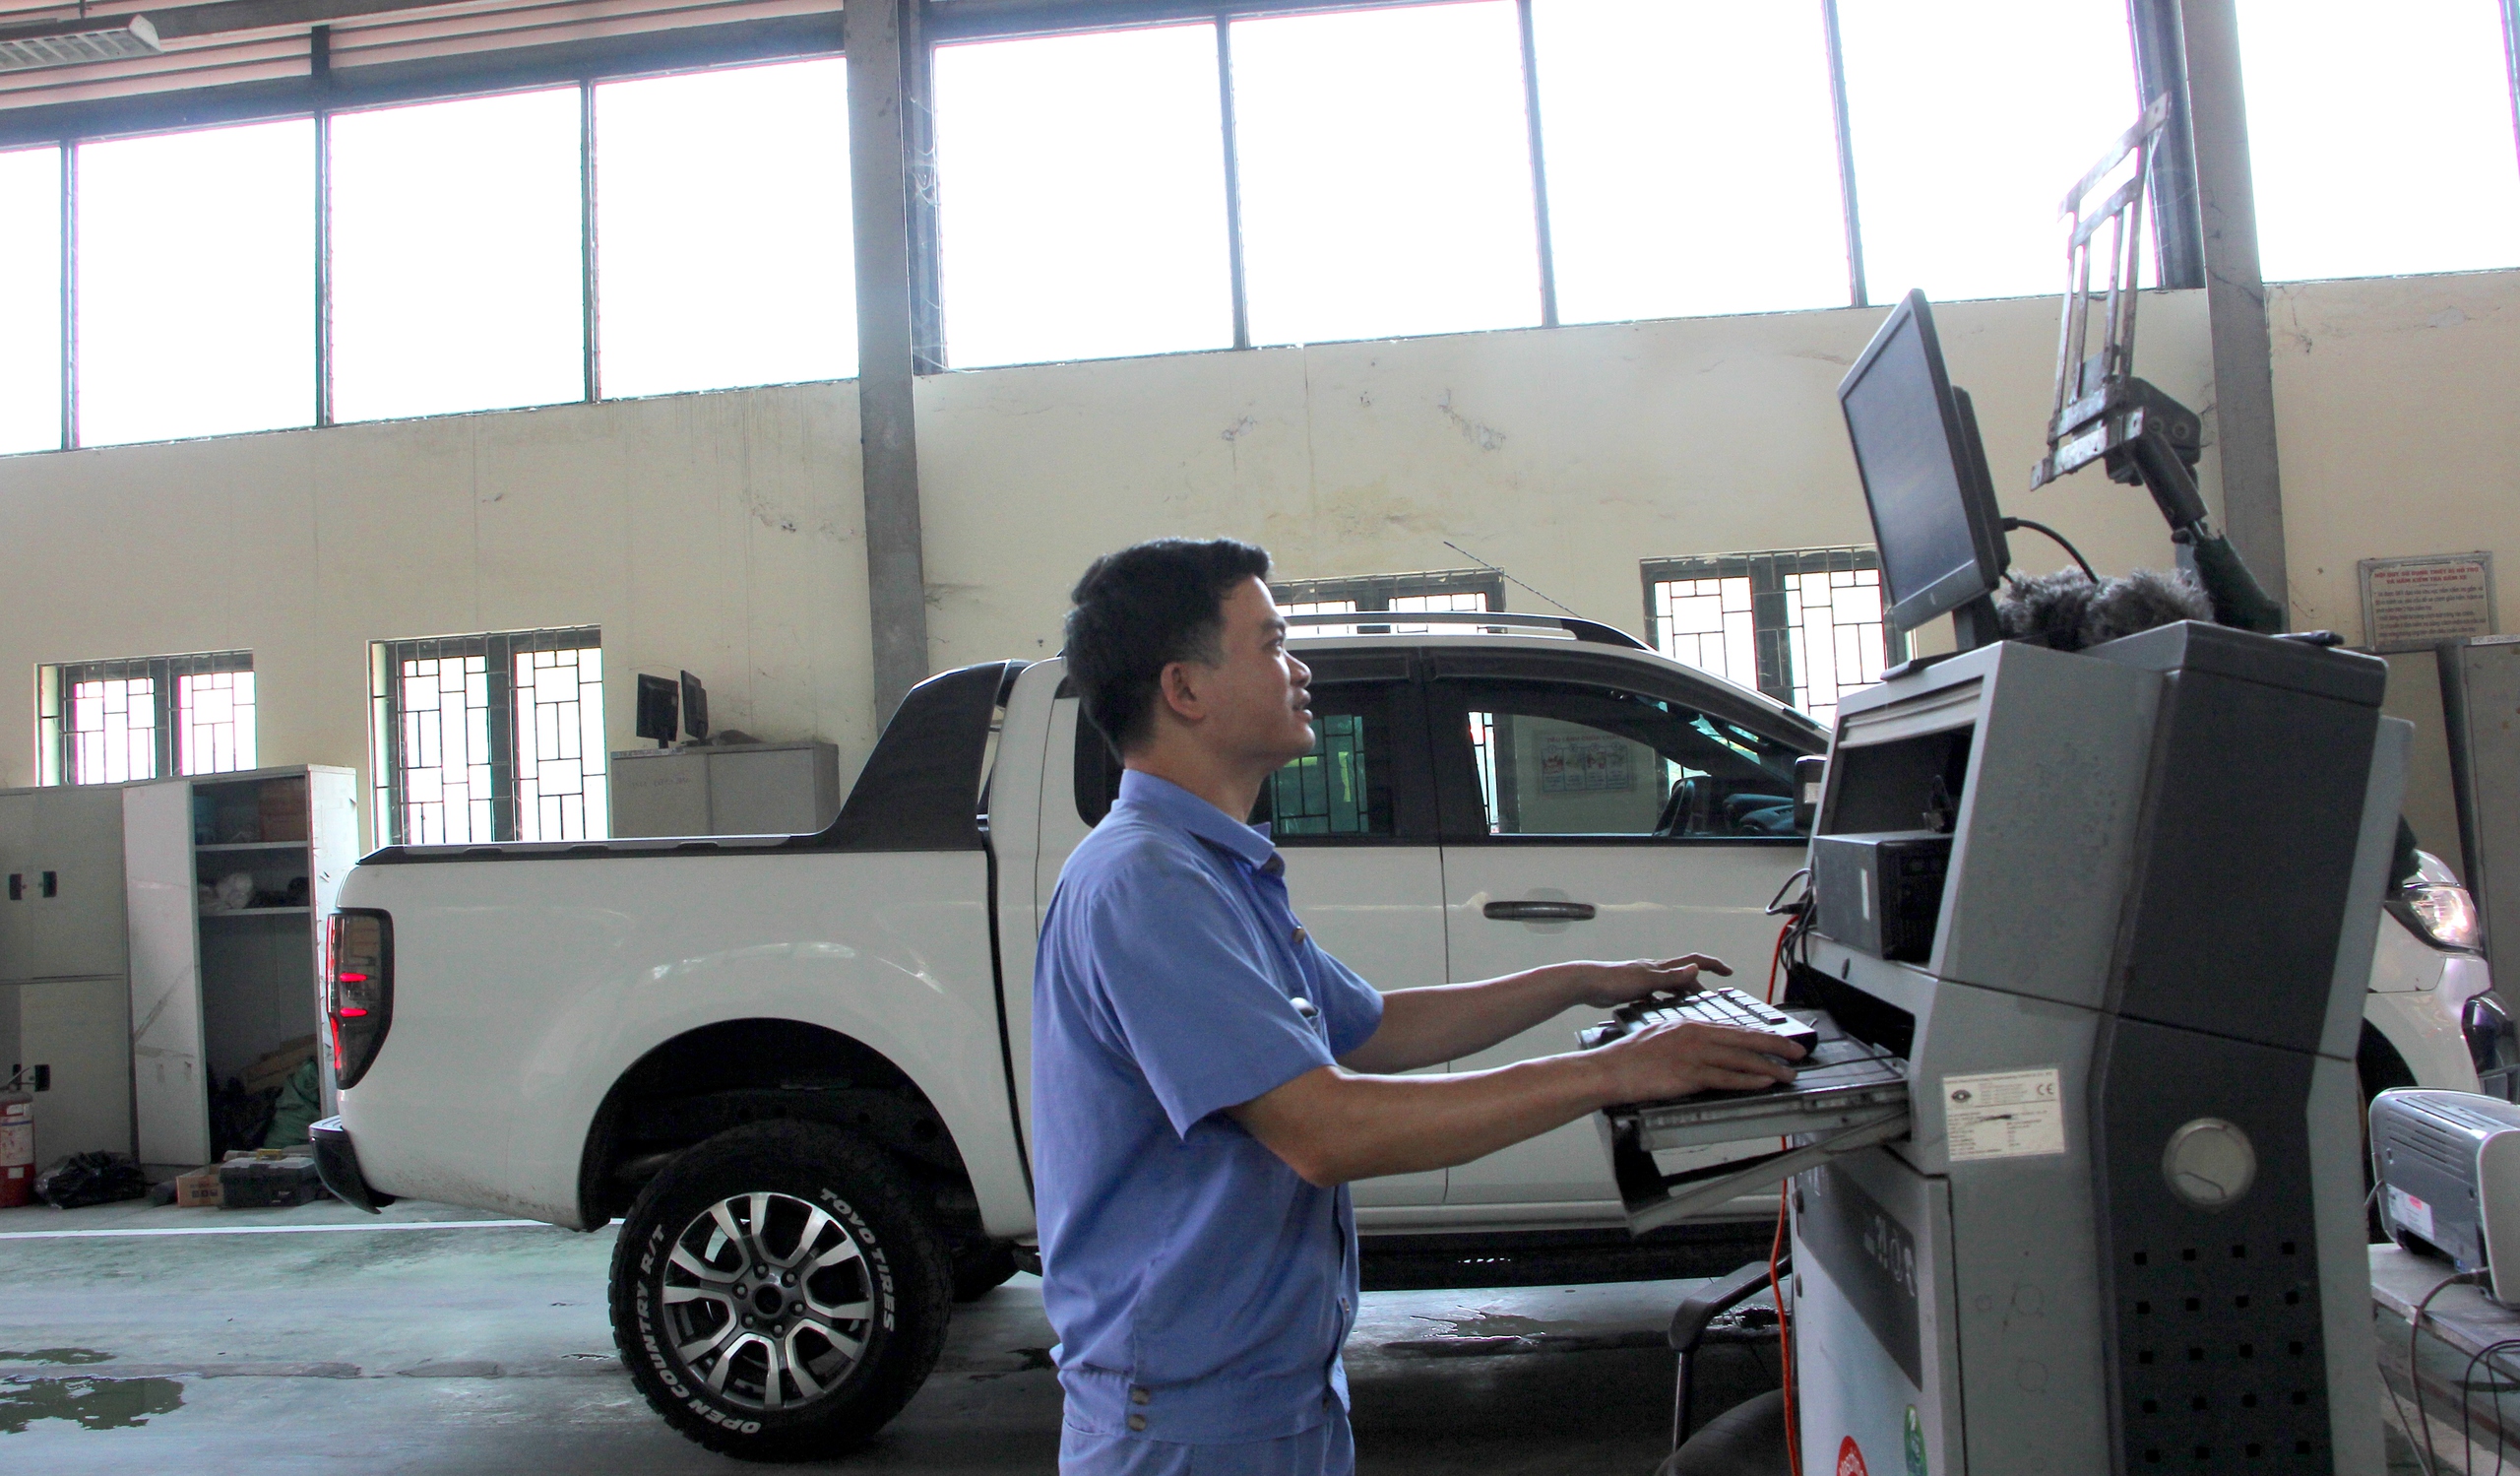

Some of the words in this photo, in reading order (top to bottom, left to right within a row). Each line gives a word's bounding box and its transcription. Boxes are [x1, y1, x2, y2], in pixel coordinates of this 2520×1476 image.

[640, 1224, 665, 1275] R/T
[820, 1187, 876, 1245] TOYO
[871, 1248, 895, 1332] TIRES
[637, 1280, 690, 1398] COUNTRY
[688, 1399, 761, 1434] OPEN
